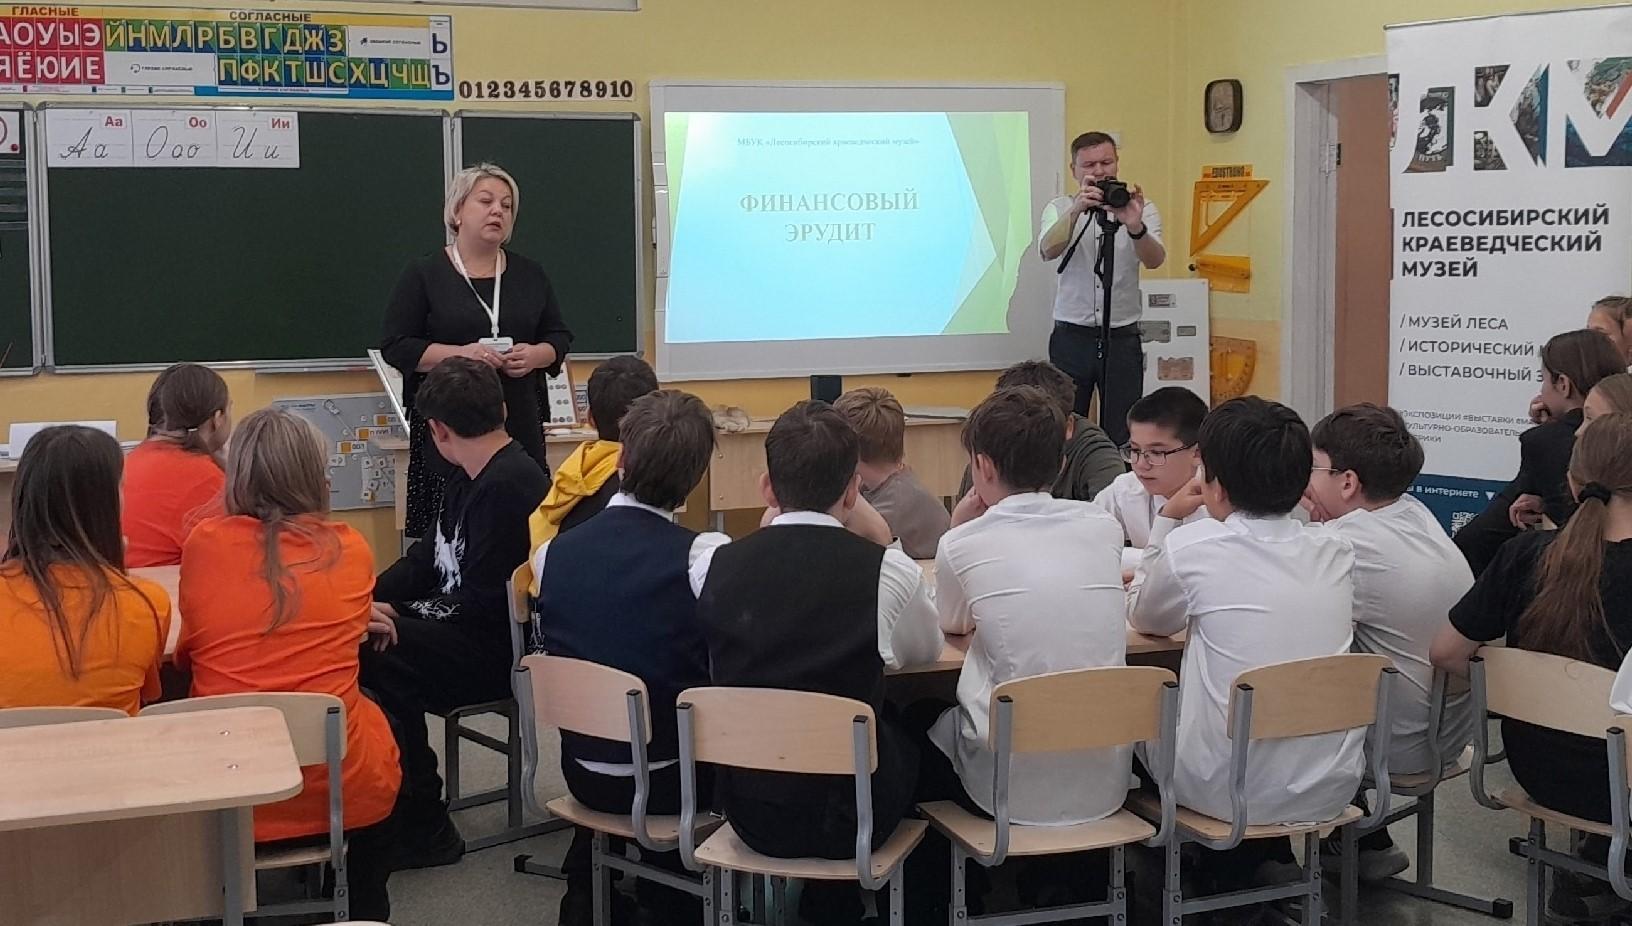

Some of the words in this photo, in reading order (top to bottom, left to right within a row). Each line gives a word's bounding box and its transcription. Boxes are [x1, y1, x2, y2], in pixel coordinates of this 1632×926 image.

[12, 6, 79, 17] ГЛАСНЫЕ
[229, 11, 312, 22] СОГЛАСНЫЕ
[104, 116, 124, 128] Аа
[188, 116, 208, 129] Оо
[271, 118, 291, 130] Ии
[739, 188, 919, 213] ФИНАНСОВЫЙ
[1402, 203, 1610, 228] ЛЕСОСИБИРСКИЙ
[785, 222, 877, 245] ЭРУДИТ
[1402, 230, 1602, 255] КРАЕВЕДЧЕСКИЙ
[1401, 256, 1478, 278] МУЗЕЙ
[1466, 318, 1509, 330] ЛЕСА
[1424, 486, 1479, 498] интернете
